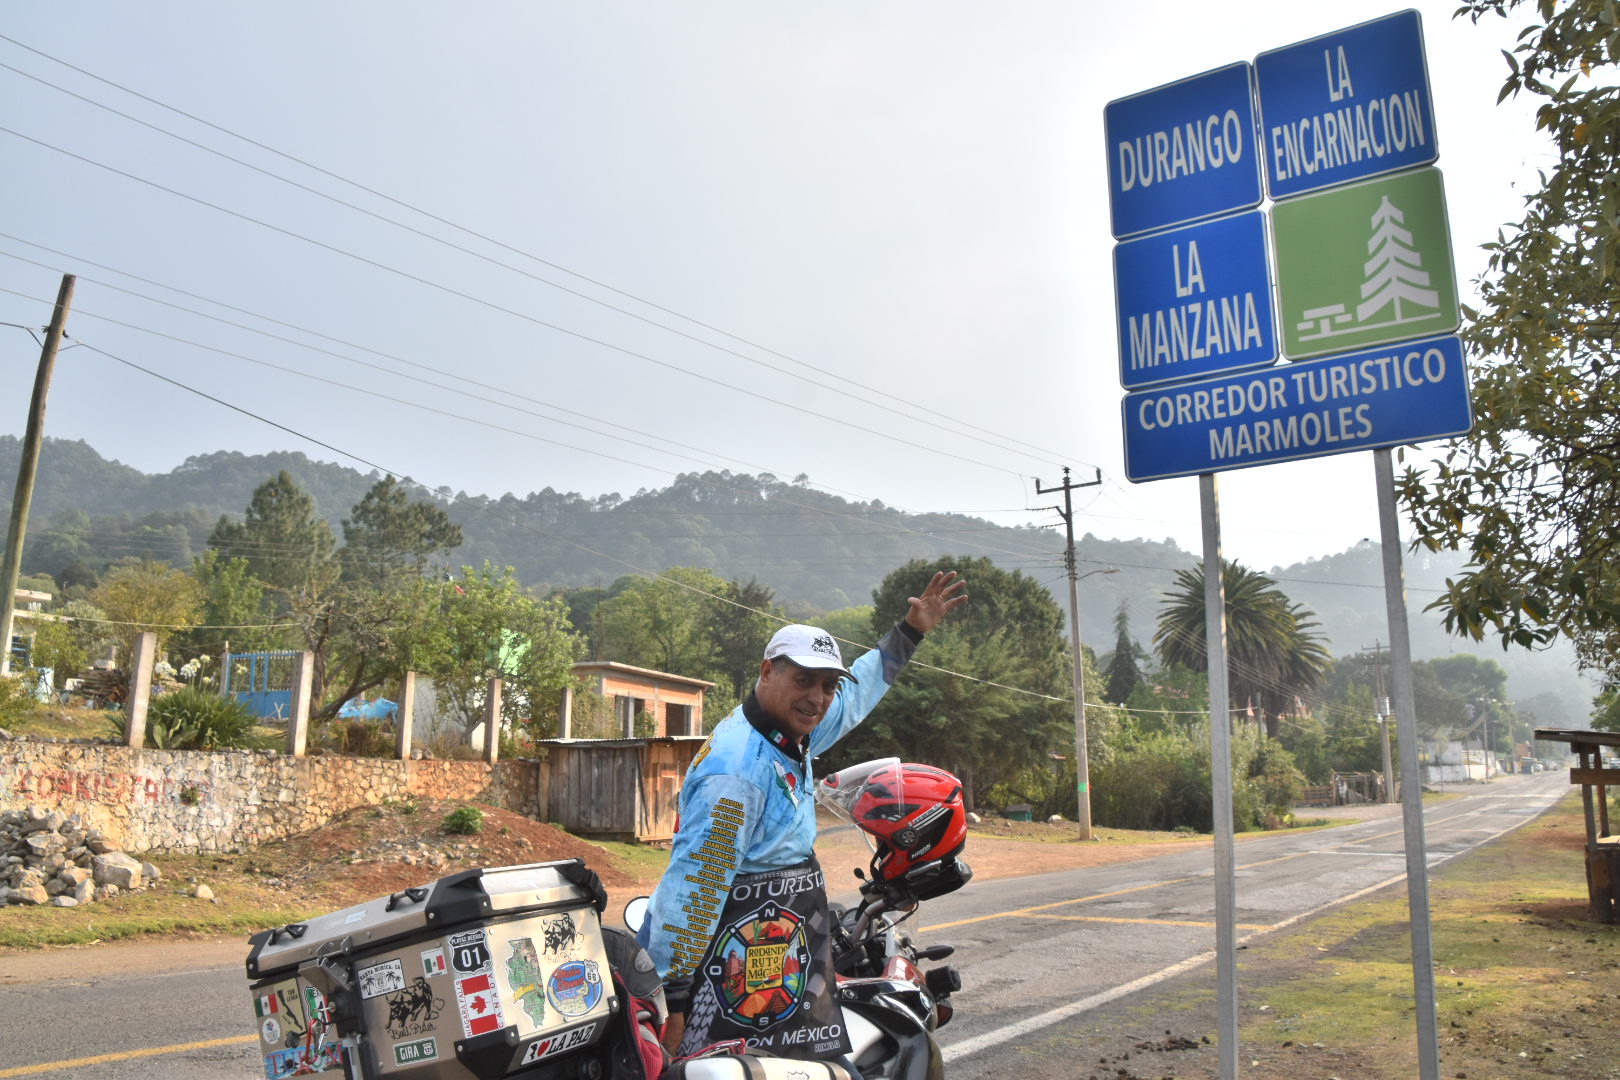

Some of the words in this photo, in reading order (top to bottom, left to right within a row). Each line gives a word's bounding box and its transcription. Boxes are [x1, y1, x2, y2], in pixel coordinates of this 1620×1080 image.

[1325, 45, 1354, 102] LA
[1119, 109, 1242, 192] DURANGO
[1271, 90, 1425, 181] ENCARNACION
[1173, 240, 1205, 298] LA
[1128, 293, 1262, 370] MANZANA
[1139, 376, 1288, 430] CORREDOR
[1291, 348, 1446, 405] TURISTICO
[1209, 404, 1372, 460] MARMOLES
[765, 909, 775, 917] N
[461, 947, 481, 968] 01
[588, 973, 597, 982] 66
[801, 954, 807, 963] E
[488, 972, 504, 1028] CANADA
[400, 1045, 419, 1060] GIRA
[546, 1037, 565, 1055] LA
[565, 1025, 594, 1048] PAZ
[782, 1024, 841, 1045] MÉXICO
